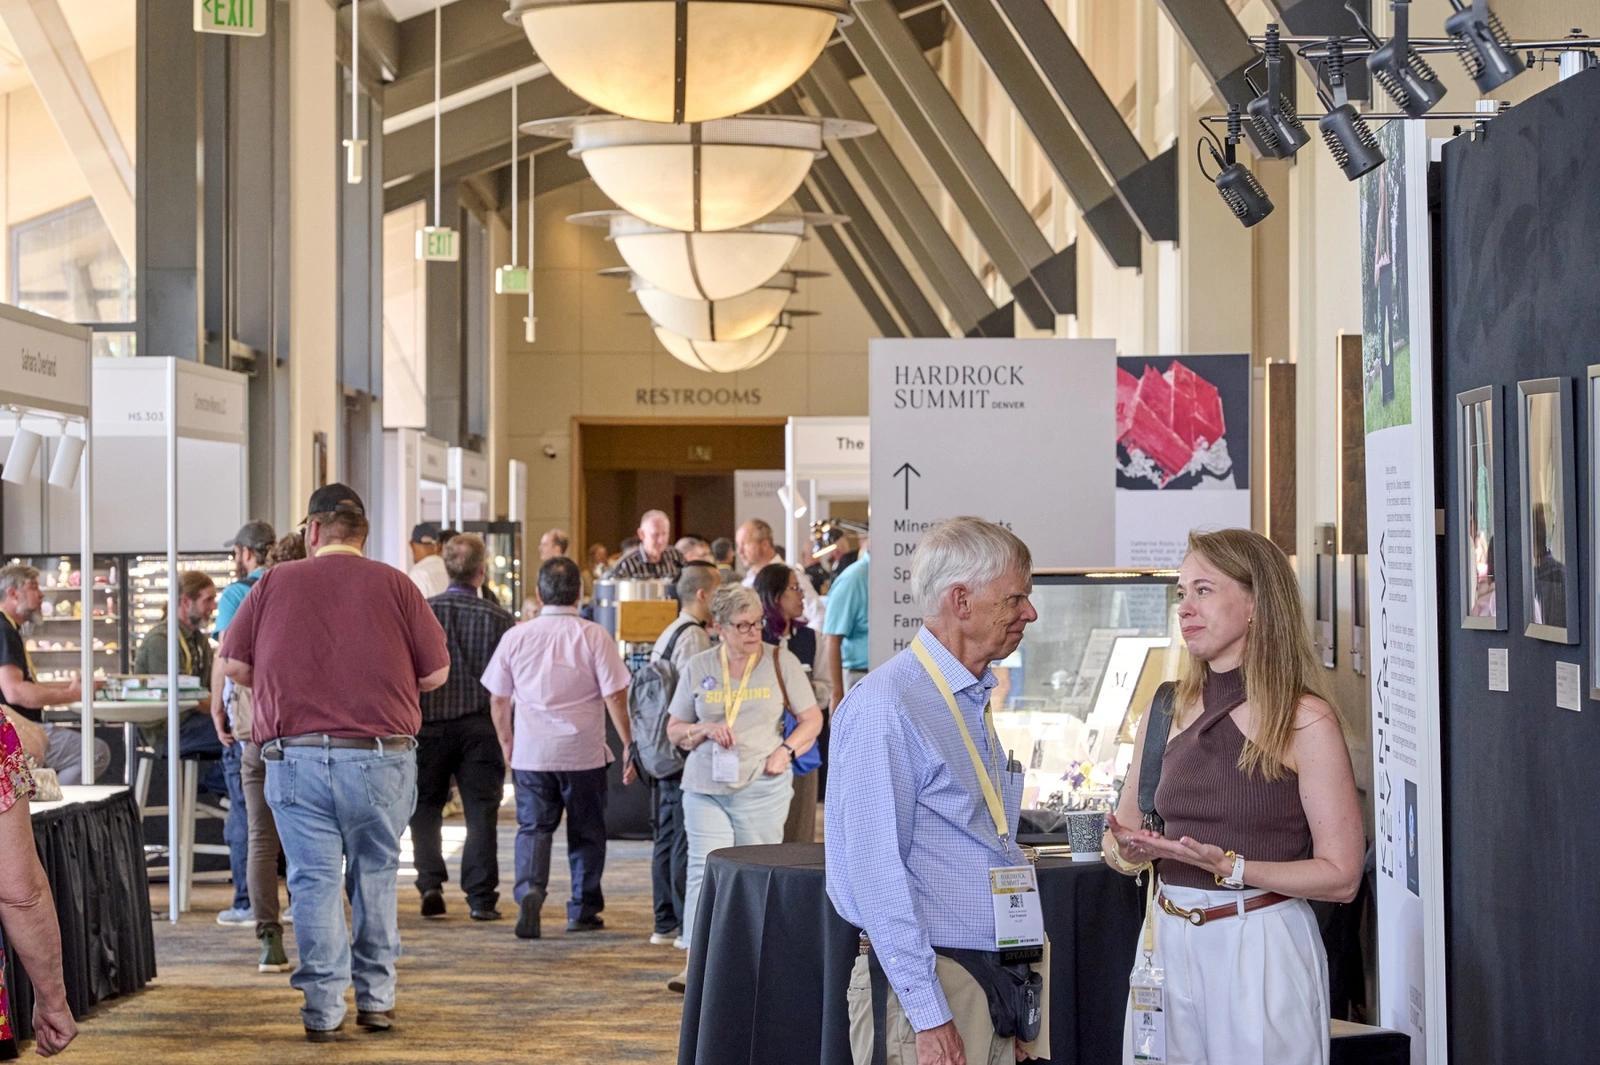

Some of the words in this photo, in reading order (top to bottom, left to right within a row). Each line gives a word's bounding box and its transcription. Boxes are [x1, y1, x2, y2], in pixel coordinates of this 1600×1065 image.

[214, 0, 253, 28] EXIT
[428, 232, 453, 256] EXIT
[895, 365, 1024, 386] HARDROCK
[635, 387, 761, 405] RESTROOMS
[894, 388, 990, 409] SUMMIT
[992, 401, 1025, 409] DENVER
[836, 436, 864, 450] The
[1376, 668, 1387, 874] KSENIA
